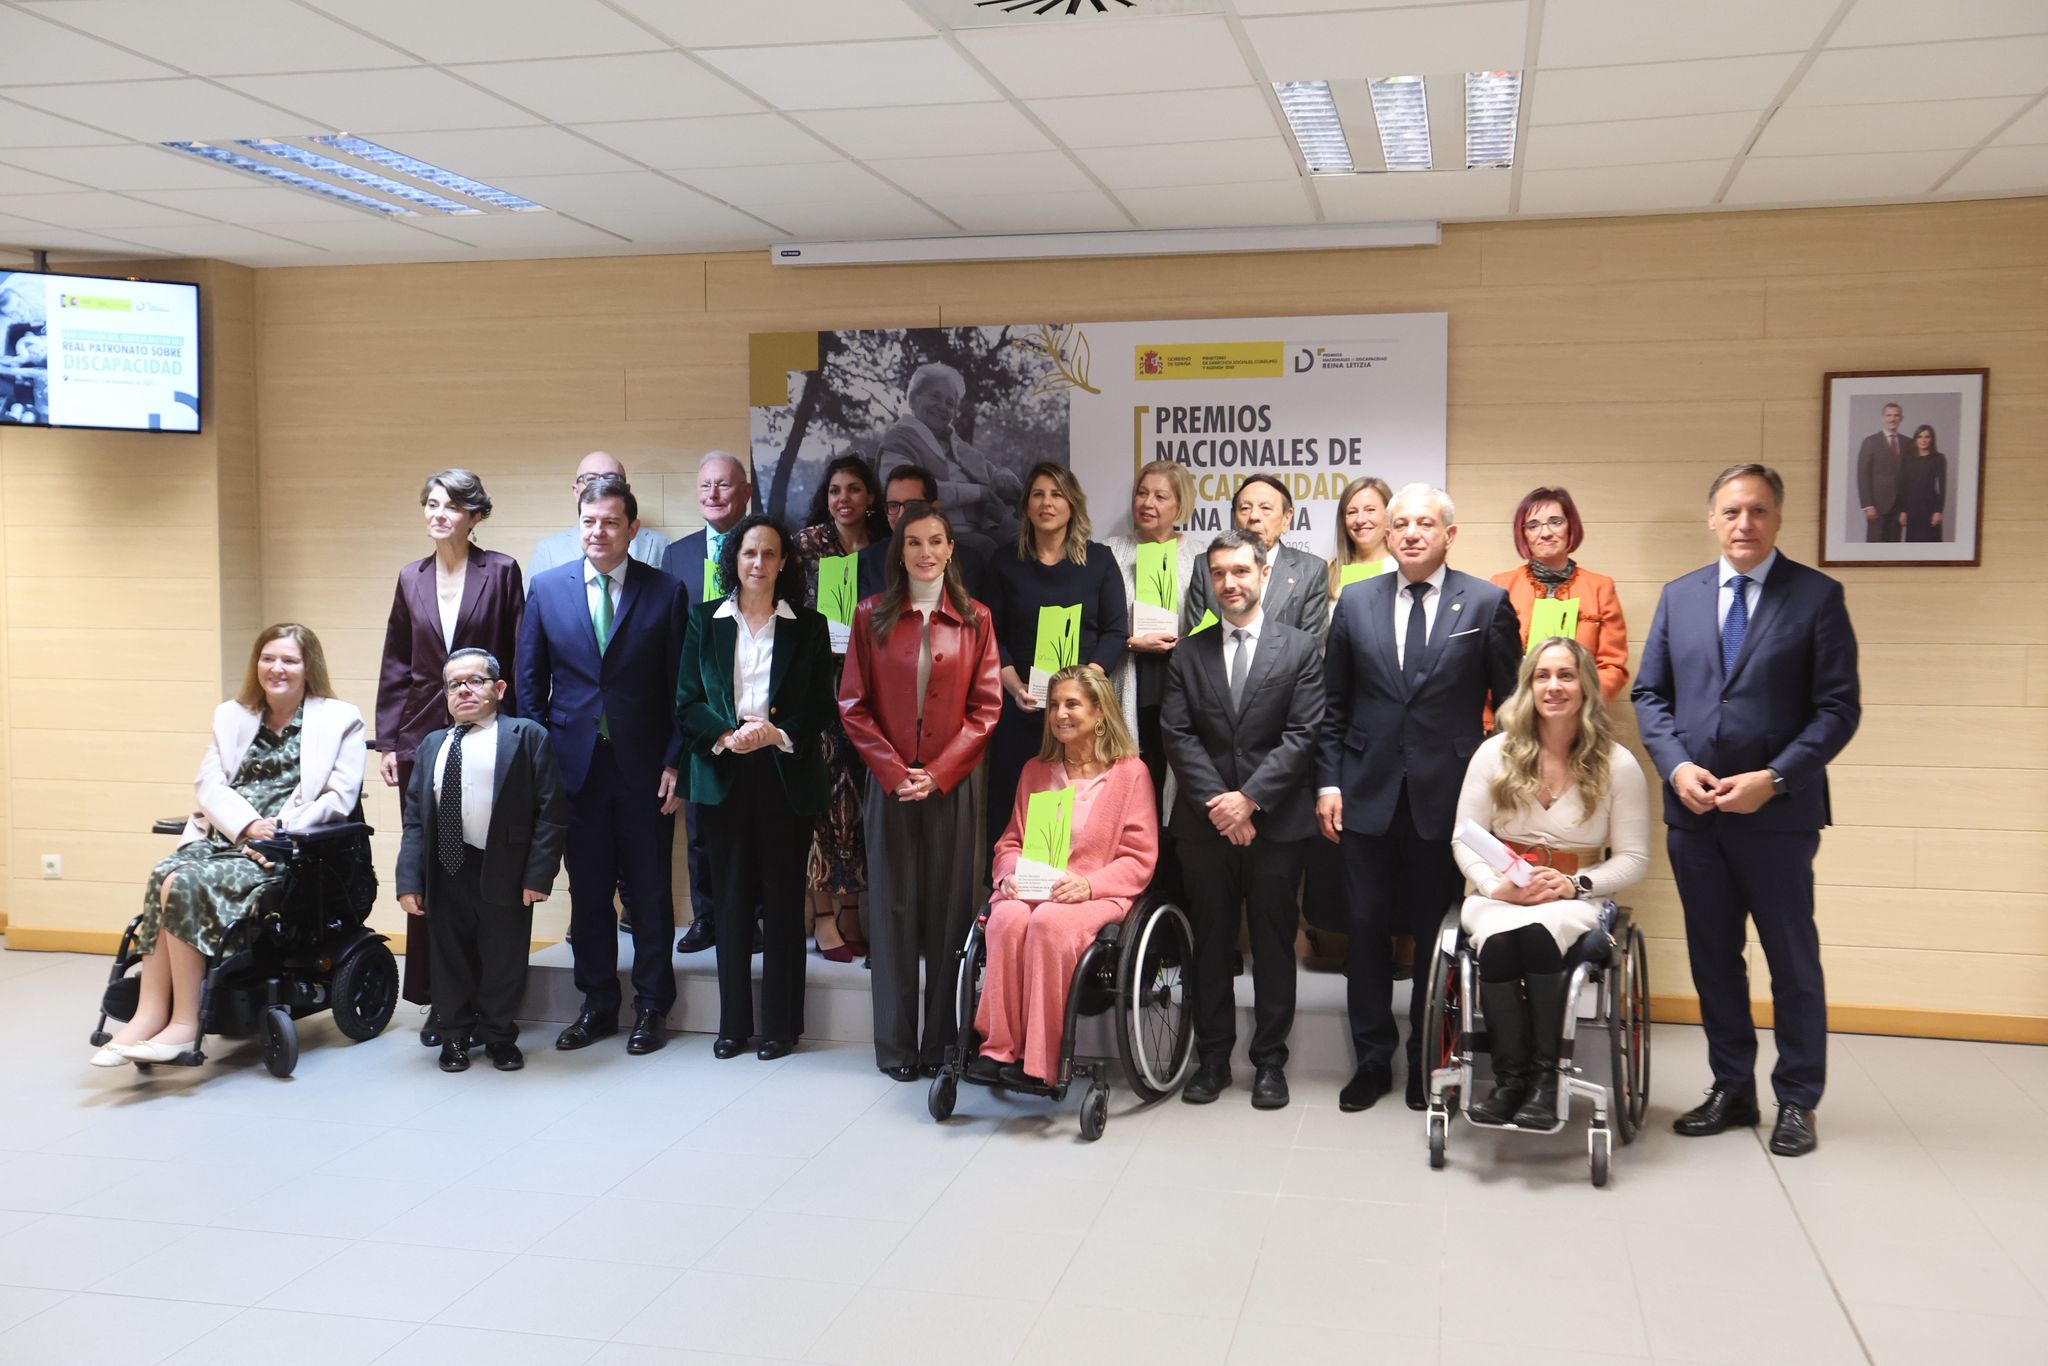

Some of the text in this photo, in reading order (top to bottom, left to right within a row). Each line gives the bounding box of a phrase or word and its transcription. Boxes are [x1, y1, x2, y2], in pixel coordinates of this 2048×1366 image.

[62, 341, 182, 357] REAL PATRONATO SOBRE
[63, 355, 183, 375] DISCAPACIDAD
[1155, 404, 1272, 434] PREMIOS
[1155, 437, 1362, 468] NACIONALES DE
